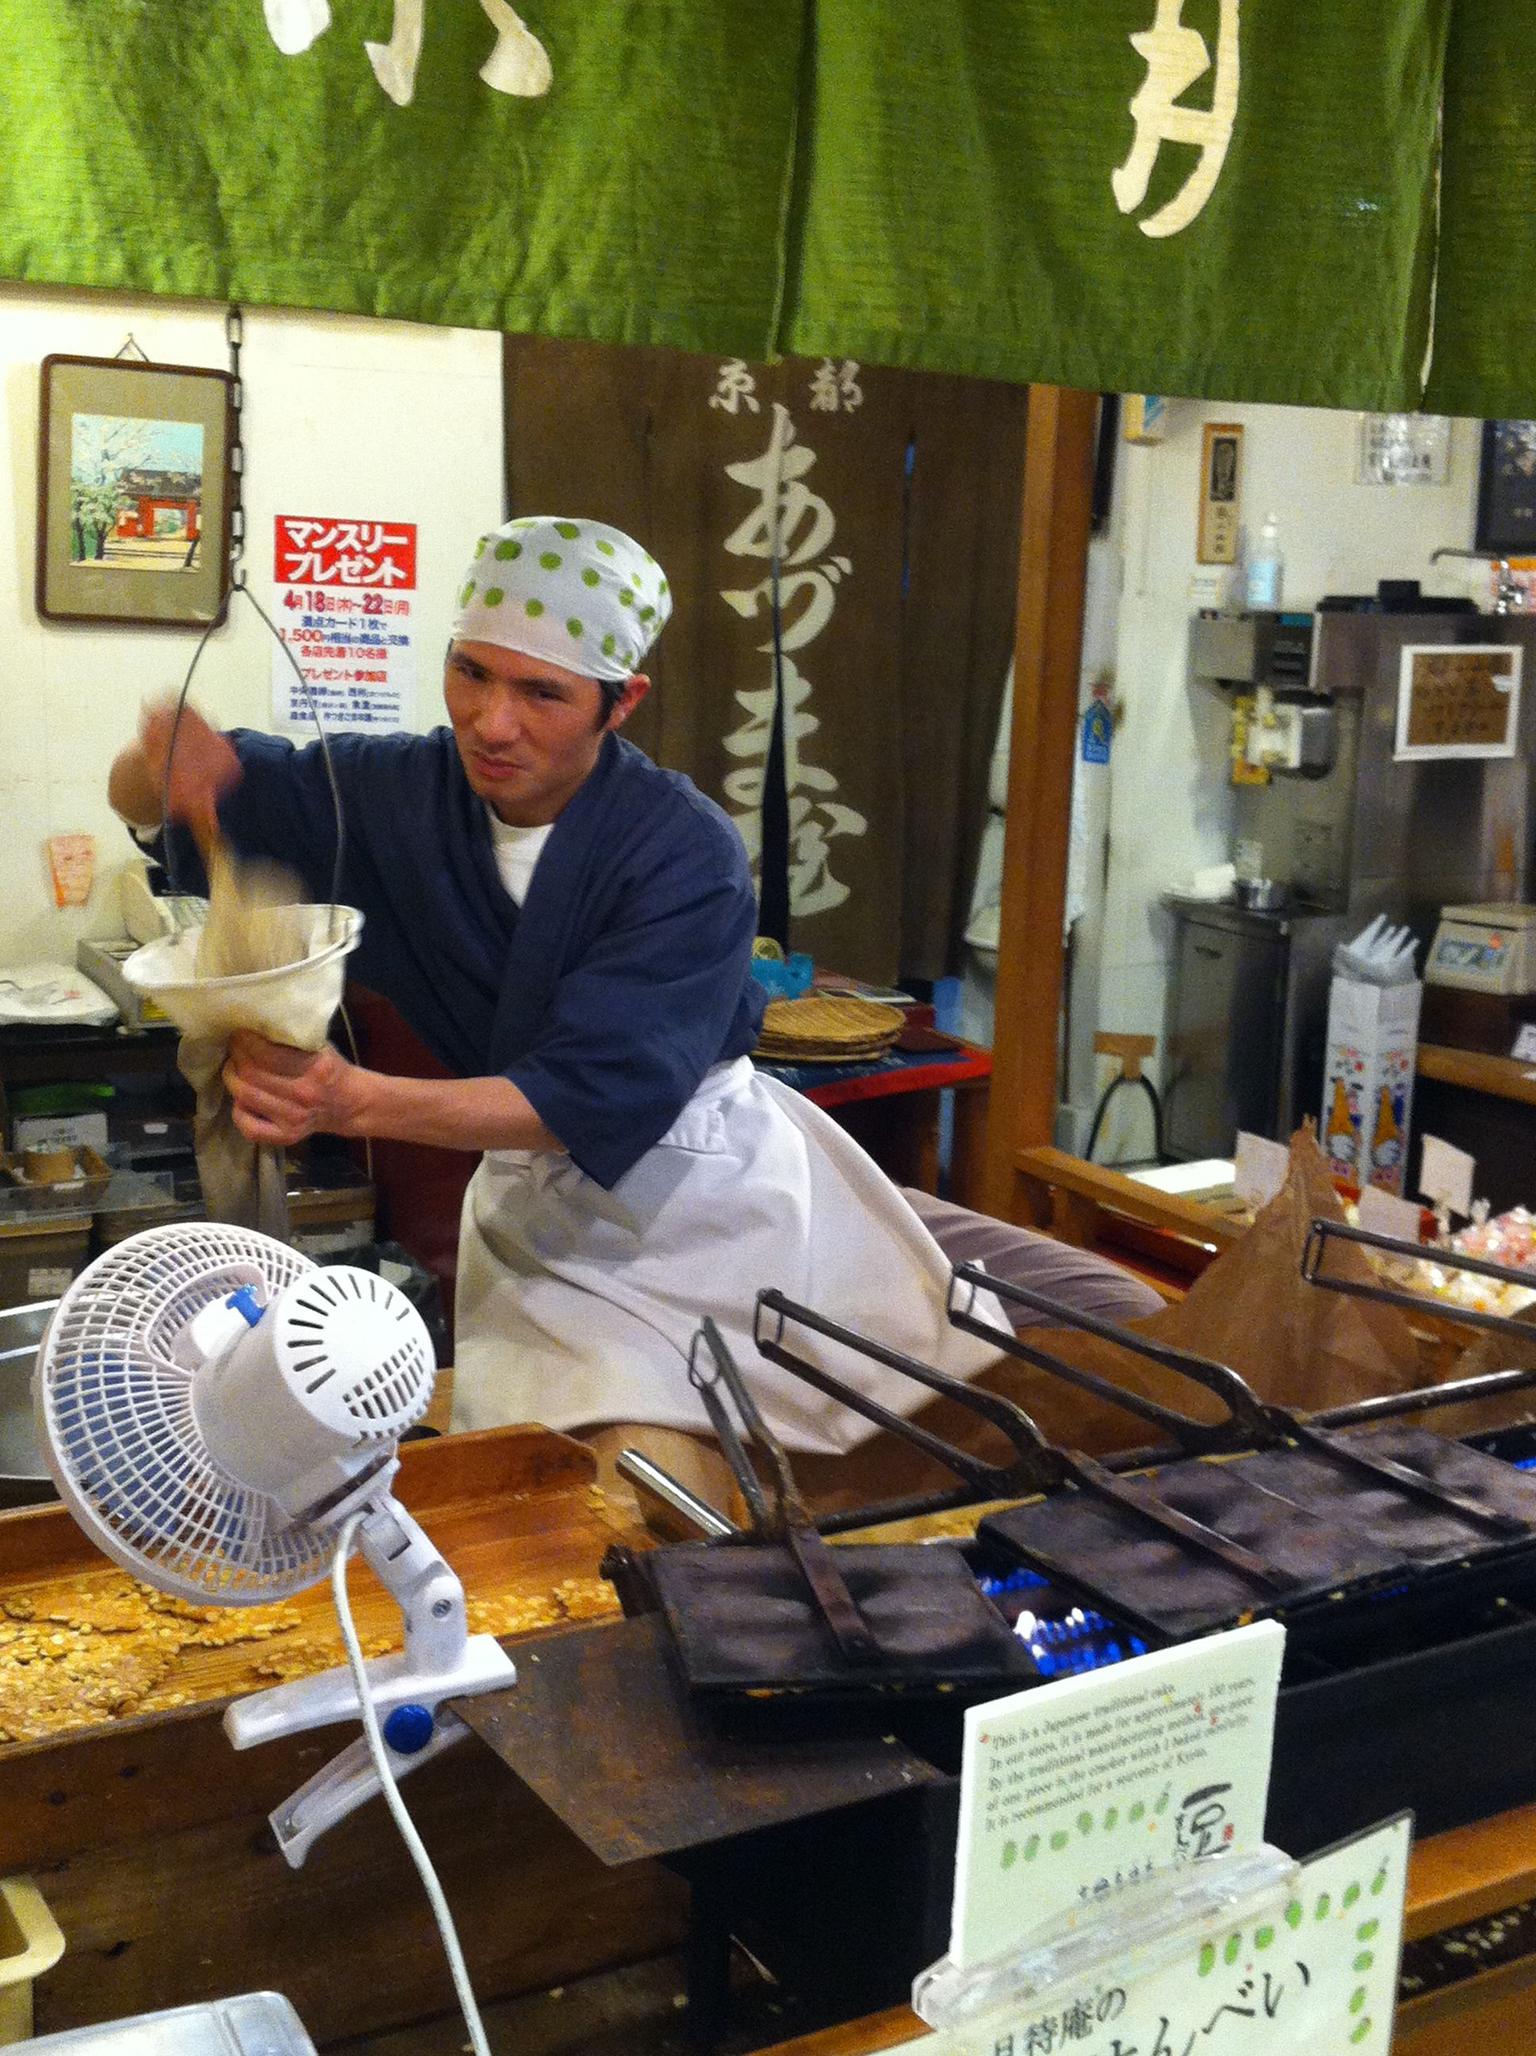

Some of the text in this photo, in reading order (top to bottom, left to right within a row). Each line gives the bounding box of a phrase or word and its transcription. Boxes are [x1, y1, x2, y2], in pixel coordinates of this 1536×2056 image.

[708, 357, 865, 414] 京都
[284, 520, 409, 553] マンスリー
[284, 551, 407, 586] プレゼント
[992, 1734, 1016, 1750] This
[1020, 1728, 1030, 1742] is
[1043, 1711, 1091, 1736] Japanese
[1086, 1721, 1112, 1739] made
[1115, 1716, 1131, 1731] for
